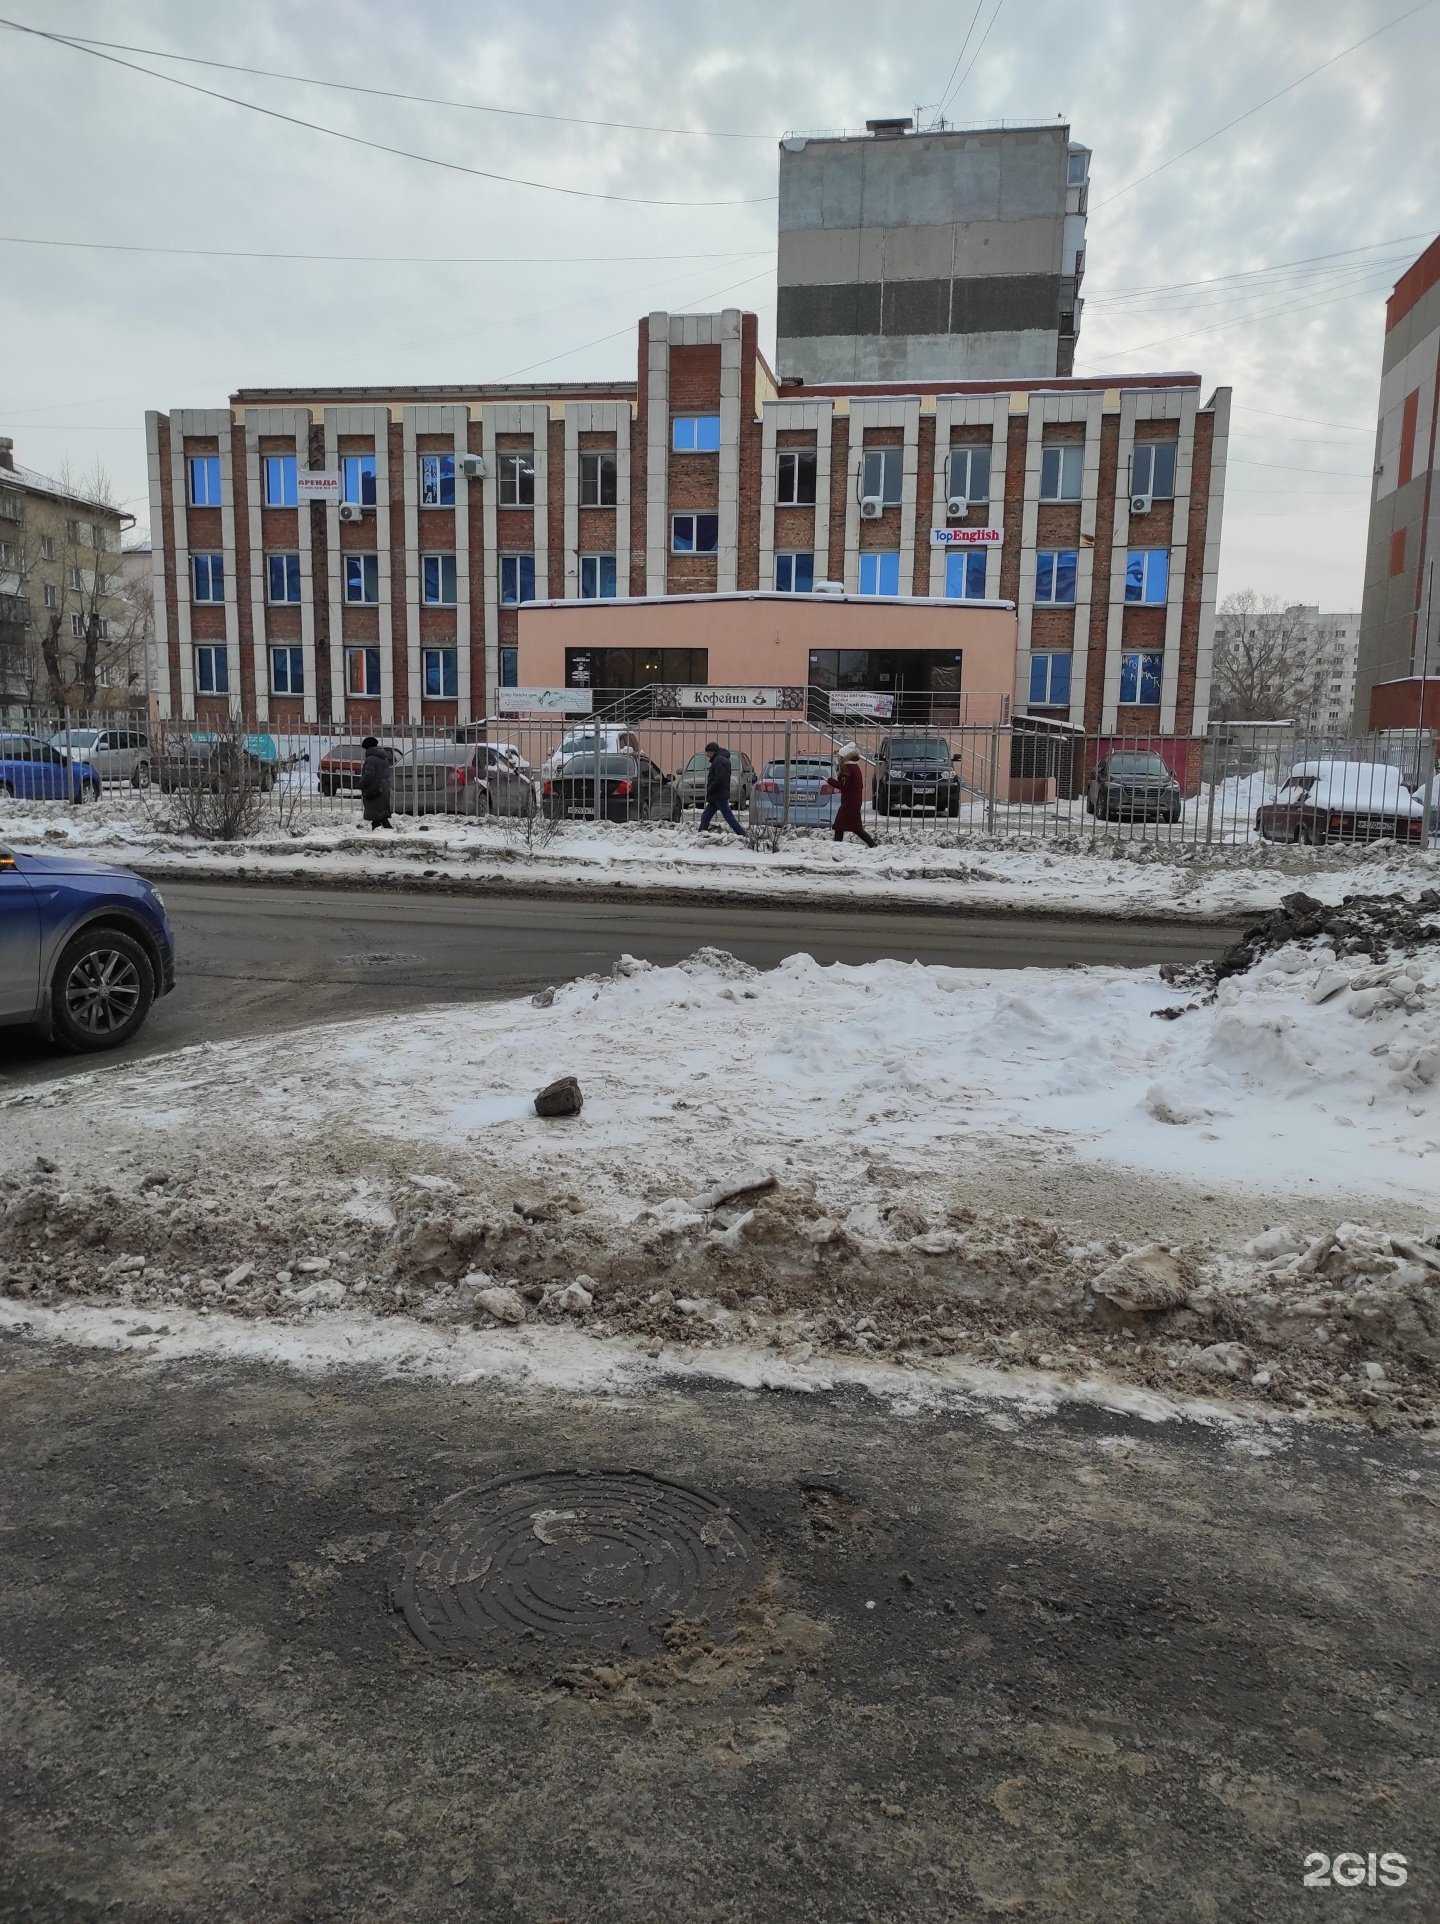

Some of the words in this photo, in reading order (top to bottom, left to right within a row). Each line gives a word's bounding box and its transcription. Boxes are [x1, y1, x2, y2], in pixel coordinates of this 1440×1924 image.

[298, 479, 338, 487] АРЕНДА
[935, 529, 1000, 543] TopEnglish
[695, 691, 747, 706] Кофейня
